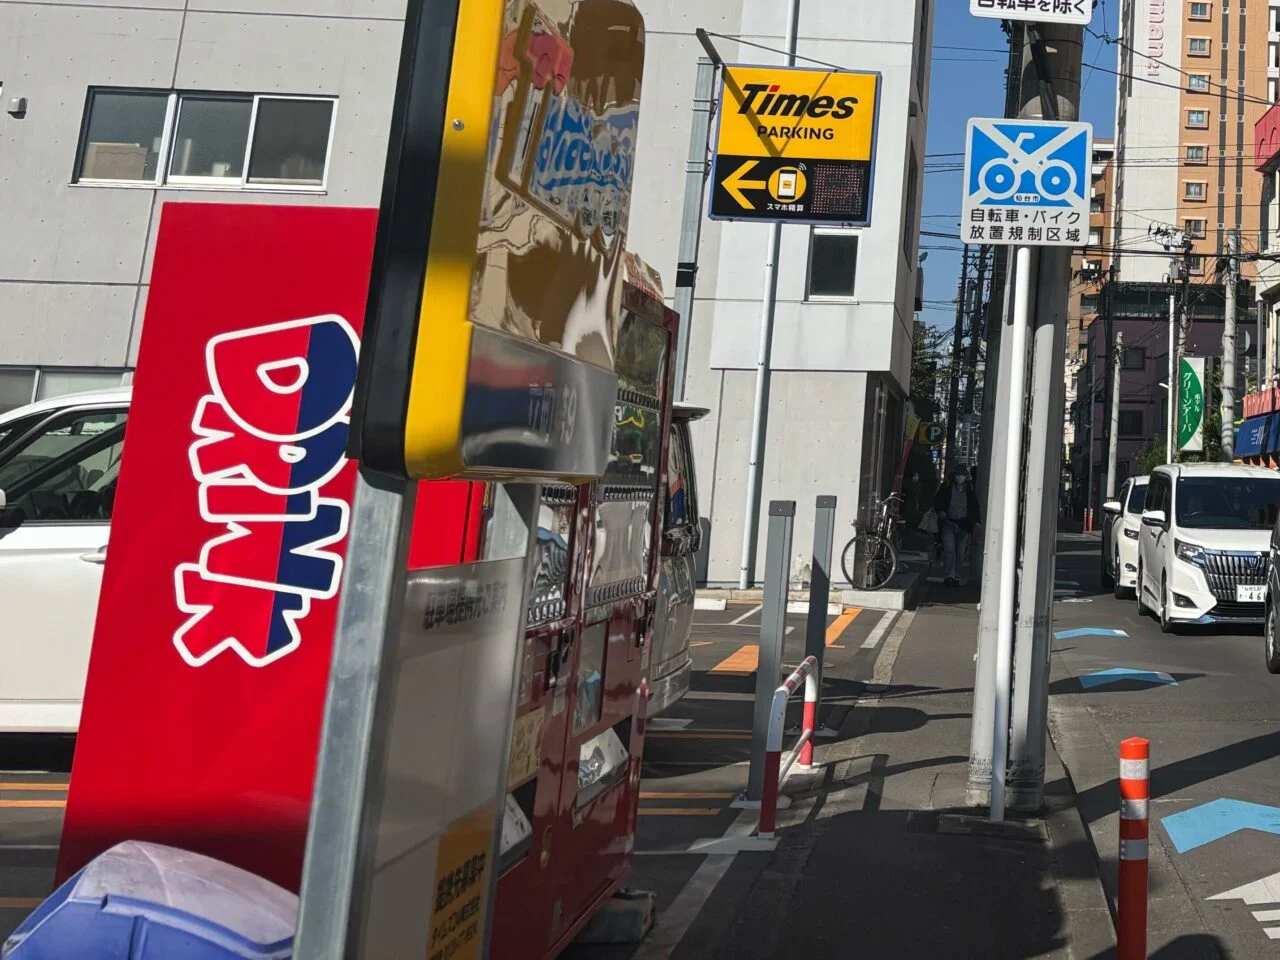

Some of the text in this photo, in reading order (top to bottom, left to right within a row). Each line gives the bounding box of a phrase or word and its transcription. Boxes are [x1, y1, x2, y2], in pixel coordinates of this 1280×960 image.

[737, 83, 859, 120] Times
[757, 125, 834, 140] PARKING
[970, 209, 1080, 225] 自転車・バイク
[970, 225, 1080, 242] 放置規制区域
[173, 313, 363, 668] DRINK
